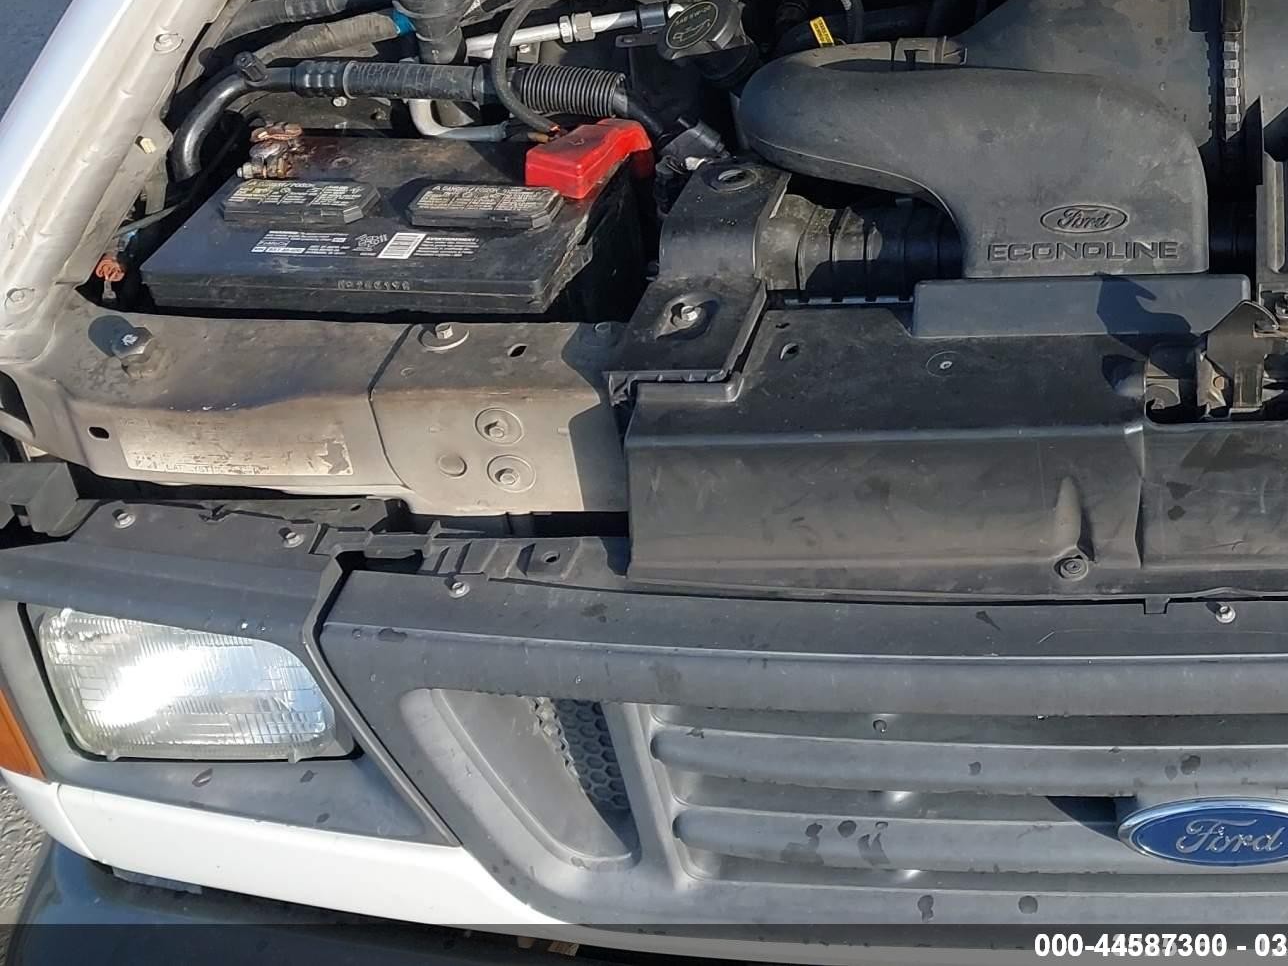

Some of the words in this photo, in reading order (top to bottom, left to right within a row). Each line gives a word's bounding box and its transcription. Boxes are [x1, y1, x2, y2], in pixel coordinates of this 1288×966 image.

[1056, 206, 1111, 229] Ford
[987, 241, 1179, 262] ECONOLINE
[1175, 818, 1286, 854] Ford
